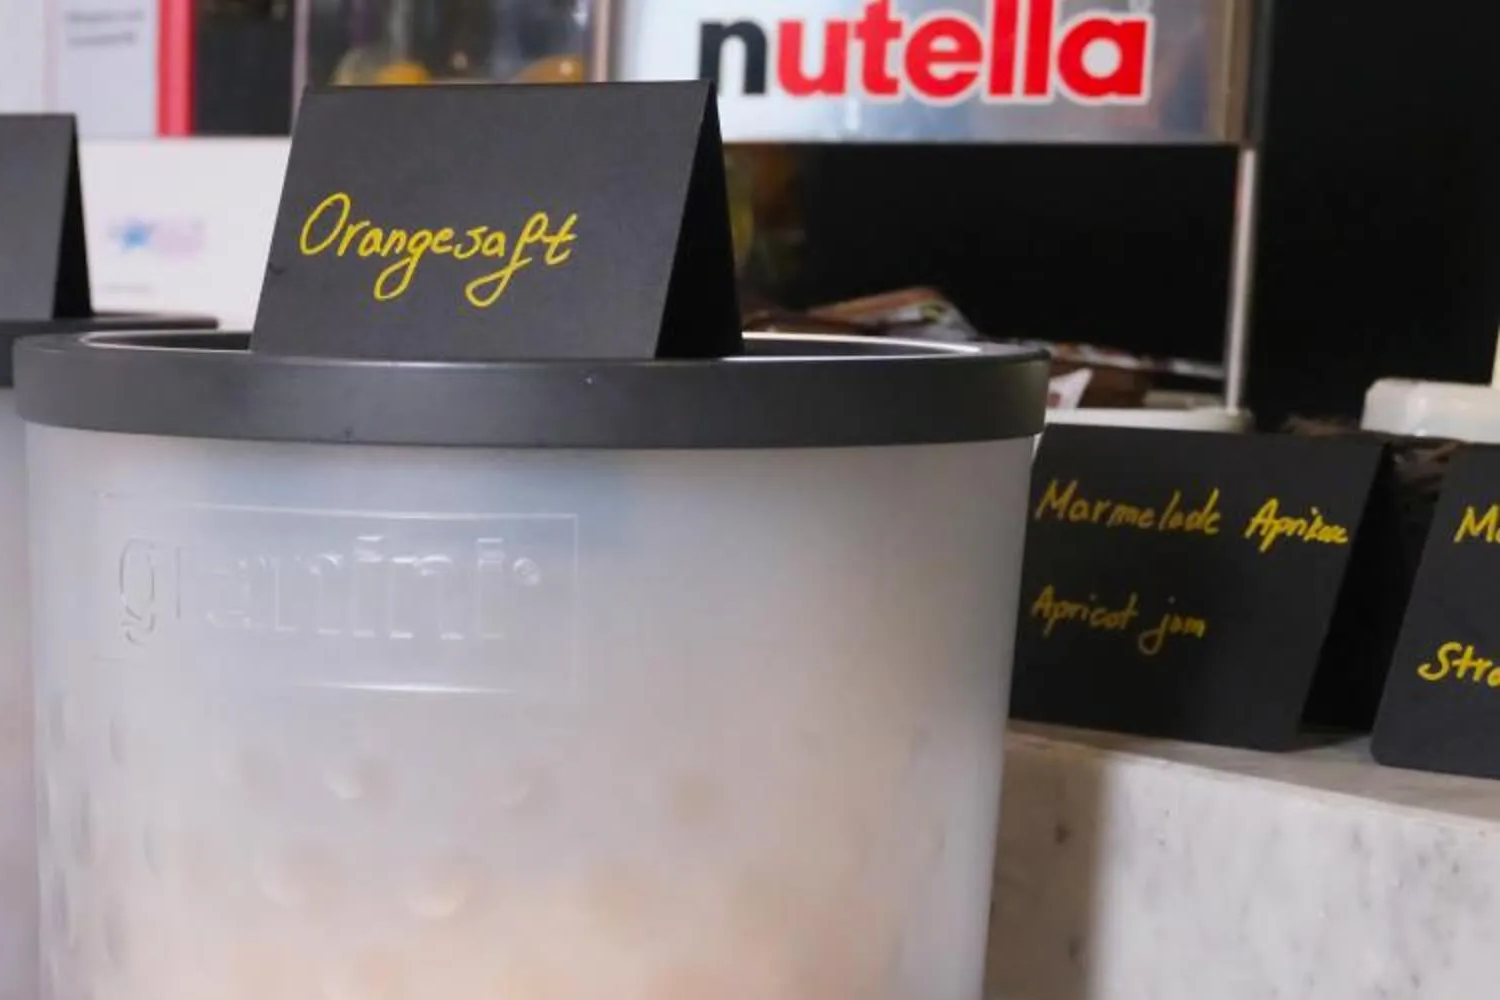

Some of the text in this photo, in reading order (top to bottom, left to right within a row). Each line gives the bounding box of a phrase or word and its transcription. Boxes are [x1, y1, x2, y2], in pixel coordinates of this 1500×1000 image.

[700, 0, 1148, 100] nutella
[300, 191, 579, 308] Orangesaft
[1034, 479, 1222, 537] Marmelade
[1030, 584, 1206, 656] Apricot jam
